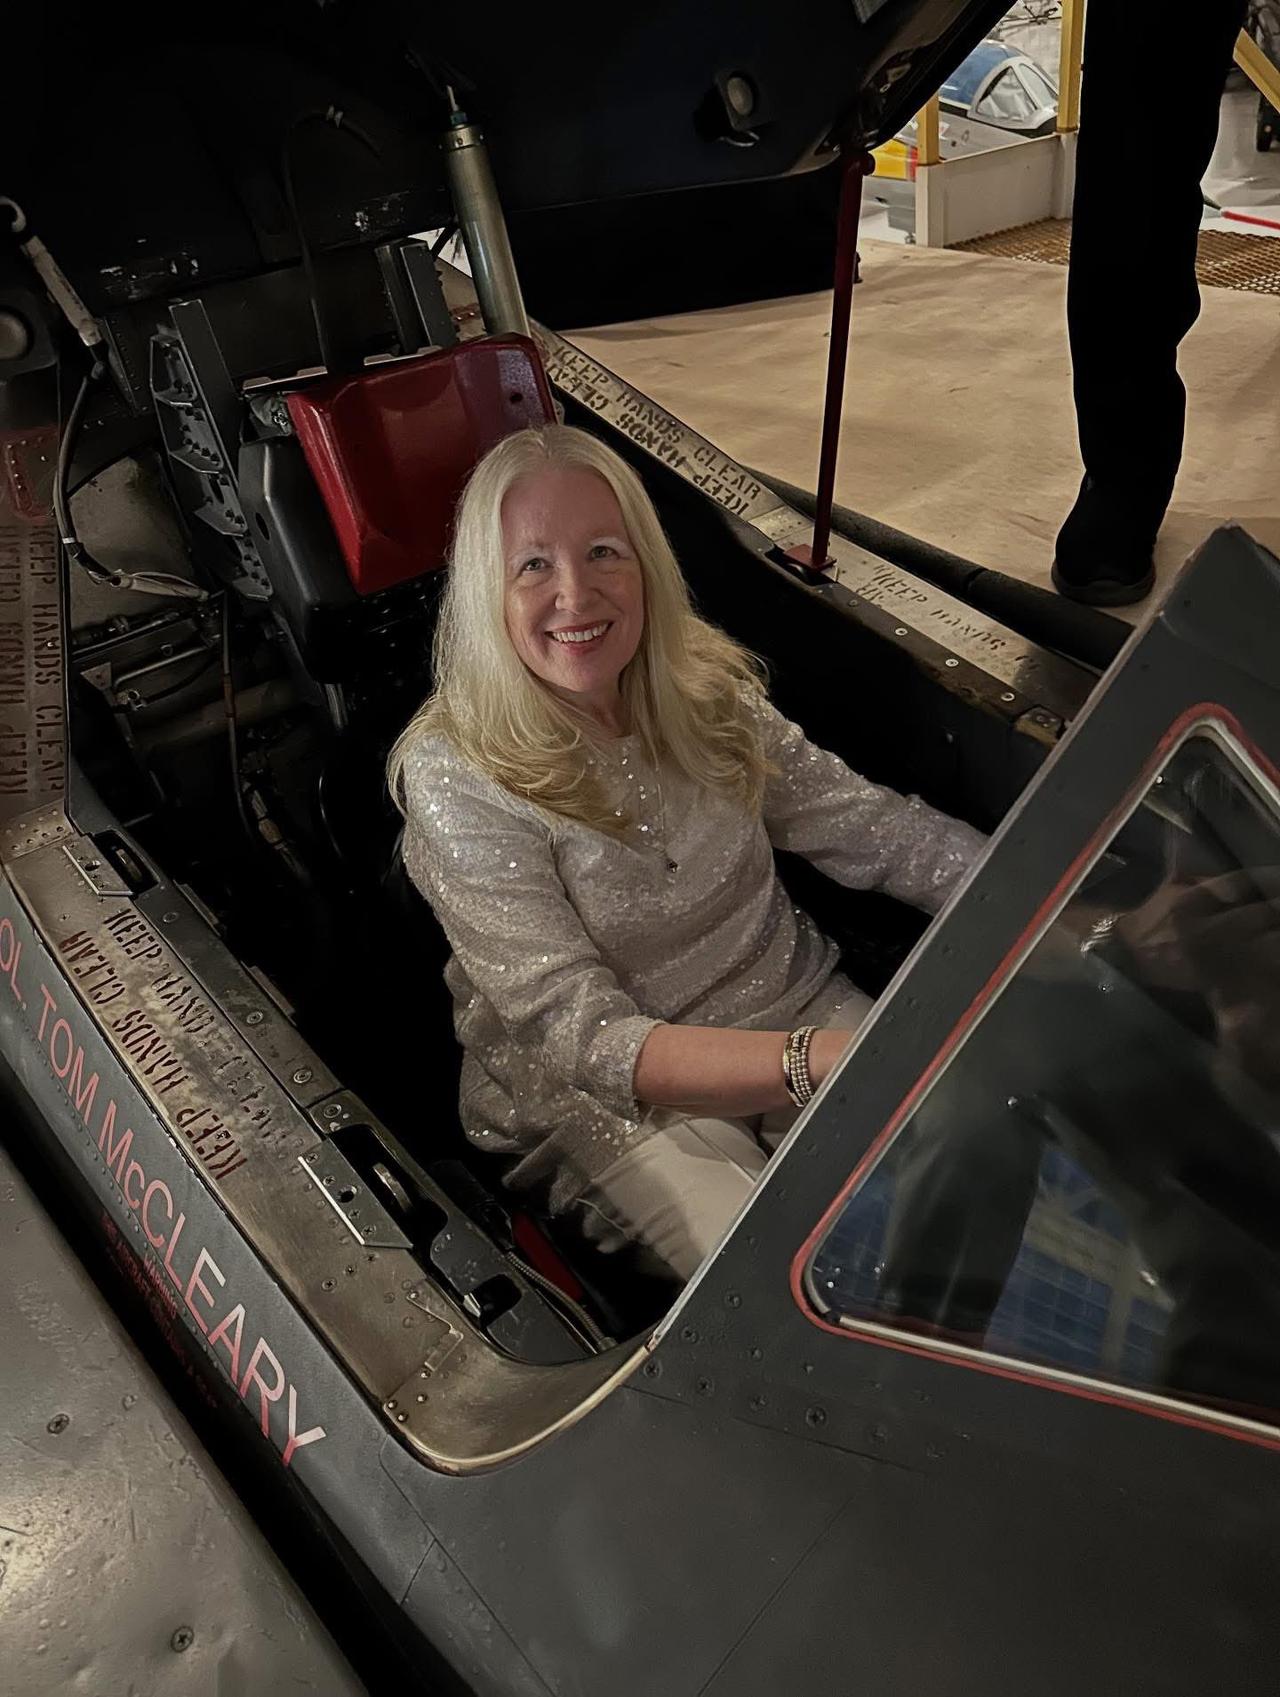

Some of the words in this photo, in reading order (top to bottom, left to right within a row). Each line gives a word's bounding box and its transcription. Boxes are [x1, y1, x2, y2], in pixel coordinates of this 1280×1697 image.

[553, 346, 609, 384] KEEP
[616, 391, 685, 444] HANDS
[693, 447, 762, 501] CLEAR
[616, 413, 687, 468] HANDS
[693, 474, 749, 516] KEEP
[32, 603, 62, 684] HANDS
[37, 705, 65, 792] CLEAR
[59, 930, 125, 1004] CLEAR
[103, 908, 162, 960] KEEP
[112, 1009, 189, 1094] HANDS
[176, 1107, 248, 1180] KEEP
[38, 983, 100, 1125] TOM
[99, 1099, 326, 1466] McCLEARY
